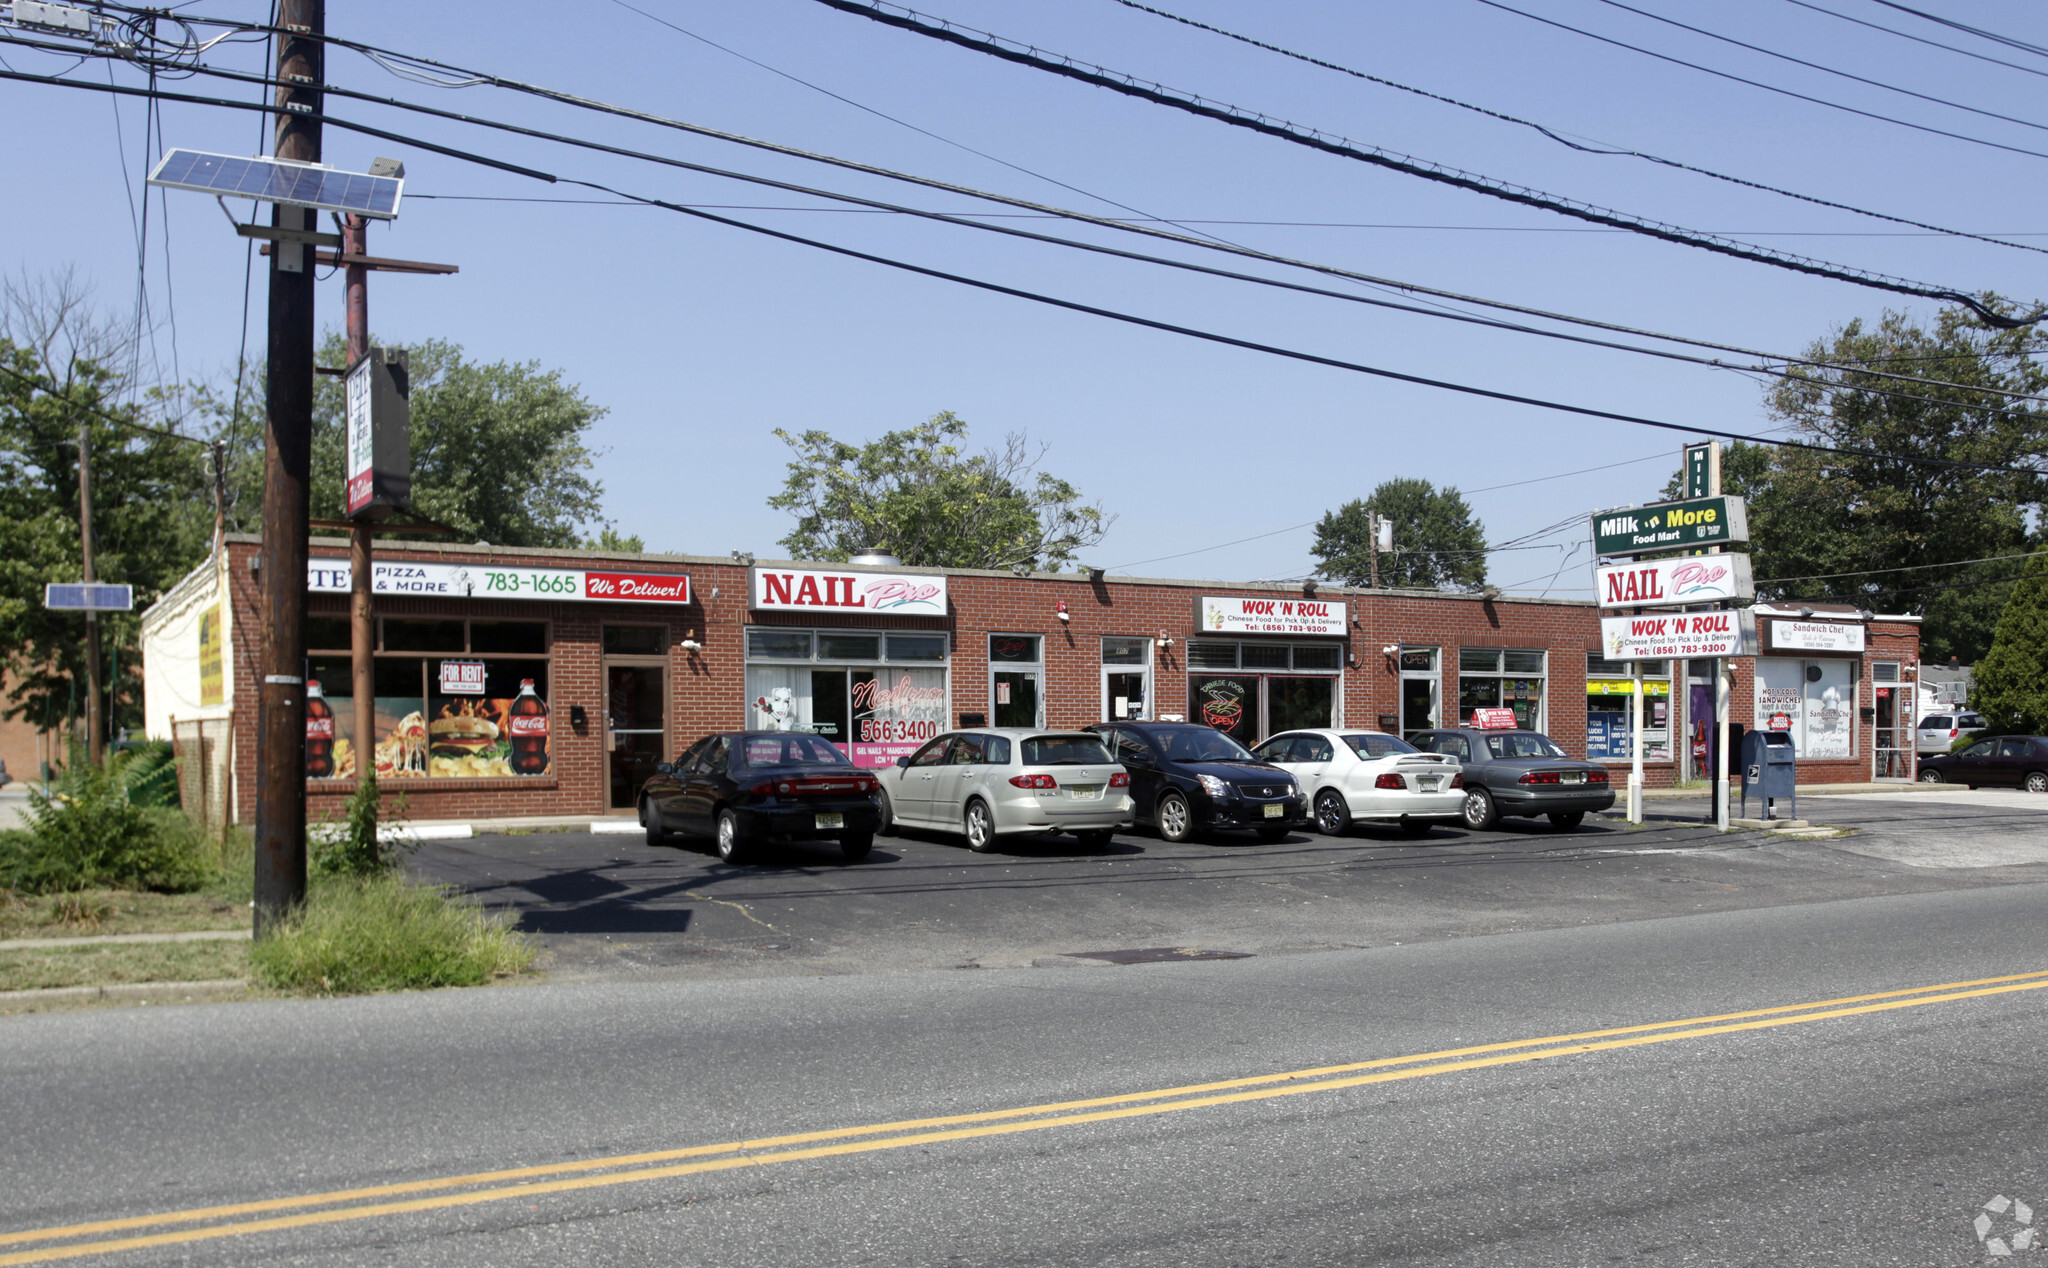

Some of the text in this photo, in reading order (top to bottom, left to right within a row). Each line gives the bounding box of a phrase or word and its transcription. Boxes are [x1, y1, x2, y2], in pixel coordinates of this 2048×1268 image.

[1600, 516, 1639, 537] Milk
[1666, 508, 1717, 528] More
[1633, 530, 1680, 545] Food Mart
[375, 567, 427, 578] PIZZA
[375, 581, 449, 592] & MORE
[485, 572, 577, 594] 783-1665
[588, 578, 684, 597] We Deliver!
[1607, 562, 1728, 603] NAIL Pro
[762, 573, 941, 609] NAIL Pro
[1242, 600, 1276, 616] WOK
[1297, 602, 1330, 617] ROLL
[1227, 614, 1254, 622] Chinese
[1255, 615, 1272, 623] Food
[1285, 616, 1298, 624] Pick
[1317, 617, 1342, 625] Delivery
[1631, 619, 1667, 637] WOK
[1691, 615, 1730, 634] ROLL
[1245, 623, 1328, 633] Tel: (856) 783-9300
[1793, 623, 1845, 634] Sandwich Chef
[993, 638, 1027, 653] Open
[1624, 638, 1648, 647] Chinese
[1650, 636, 1665, 645] Food
[1678, 635, 1691, 643] Pick
[1704, 634, 1709, 642] &
[1711, 633, 1738, 642] Delivery
[1634, 643, 1727, 656] Tel: (856) 783-9300
[1404, 654, 1428, 665] OPEN
[444, 664, 482, 682] FOR RENT
[1227, 680, 1245, 694] FOOD
[1759, 696, 1801, 704] SANDWICHES
[1211, 716, 1235, 726] OPEN
[861, 720, 937, 742] 566-3400
[856, 747, 916, 755] GEL NAILS MANICURES
